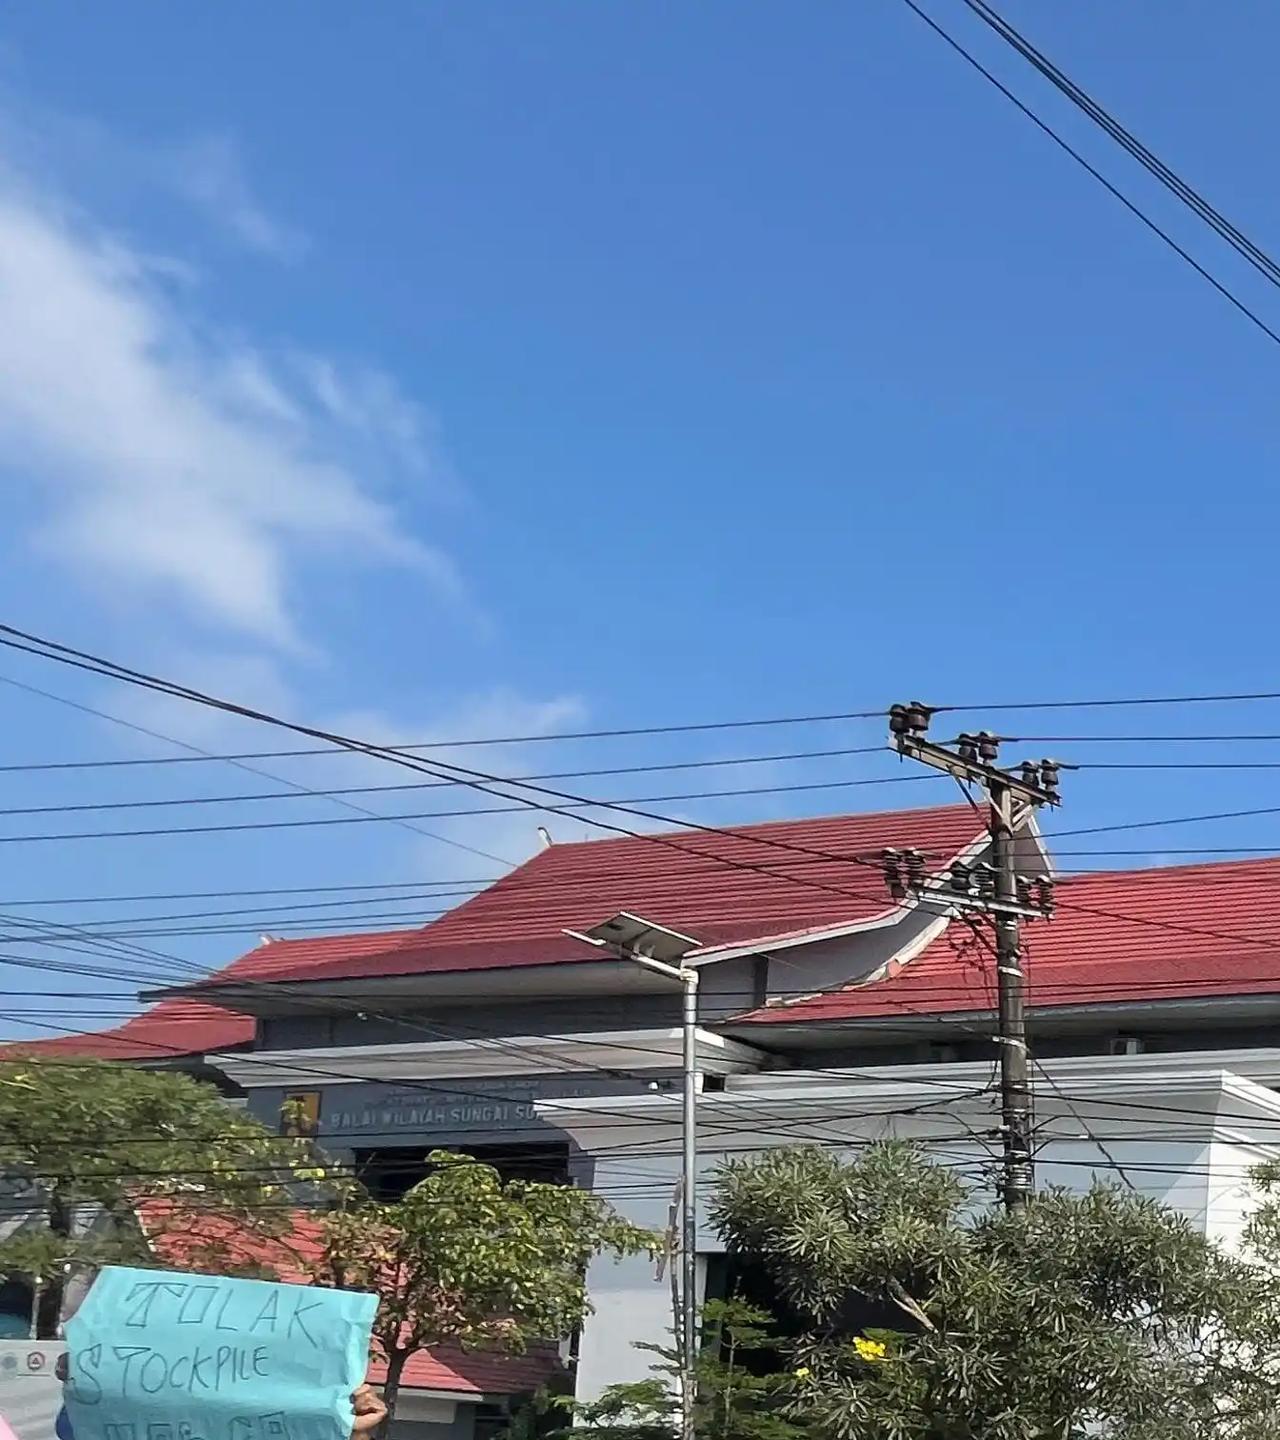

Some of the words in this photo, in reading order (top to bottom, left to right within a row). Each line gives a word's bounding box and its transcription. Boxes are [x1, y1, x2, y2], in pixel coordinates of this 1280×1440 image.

[330, 1110, 376, 1129] BALAI
[382, 1107, 447, 1128] WILAYAH
[452, 1105, 509, 1125] SUNGAI
[125, 1282, 323, 1348] TOLAK
[71, 1343, 269, 1405] STOCKPILE
